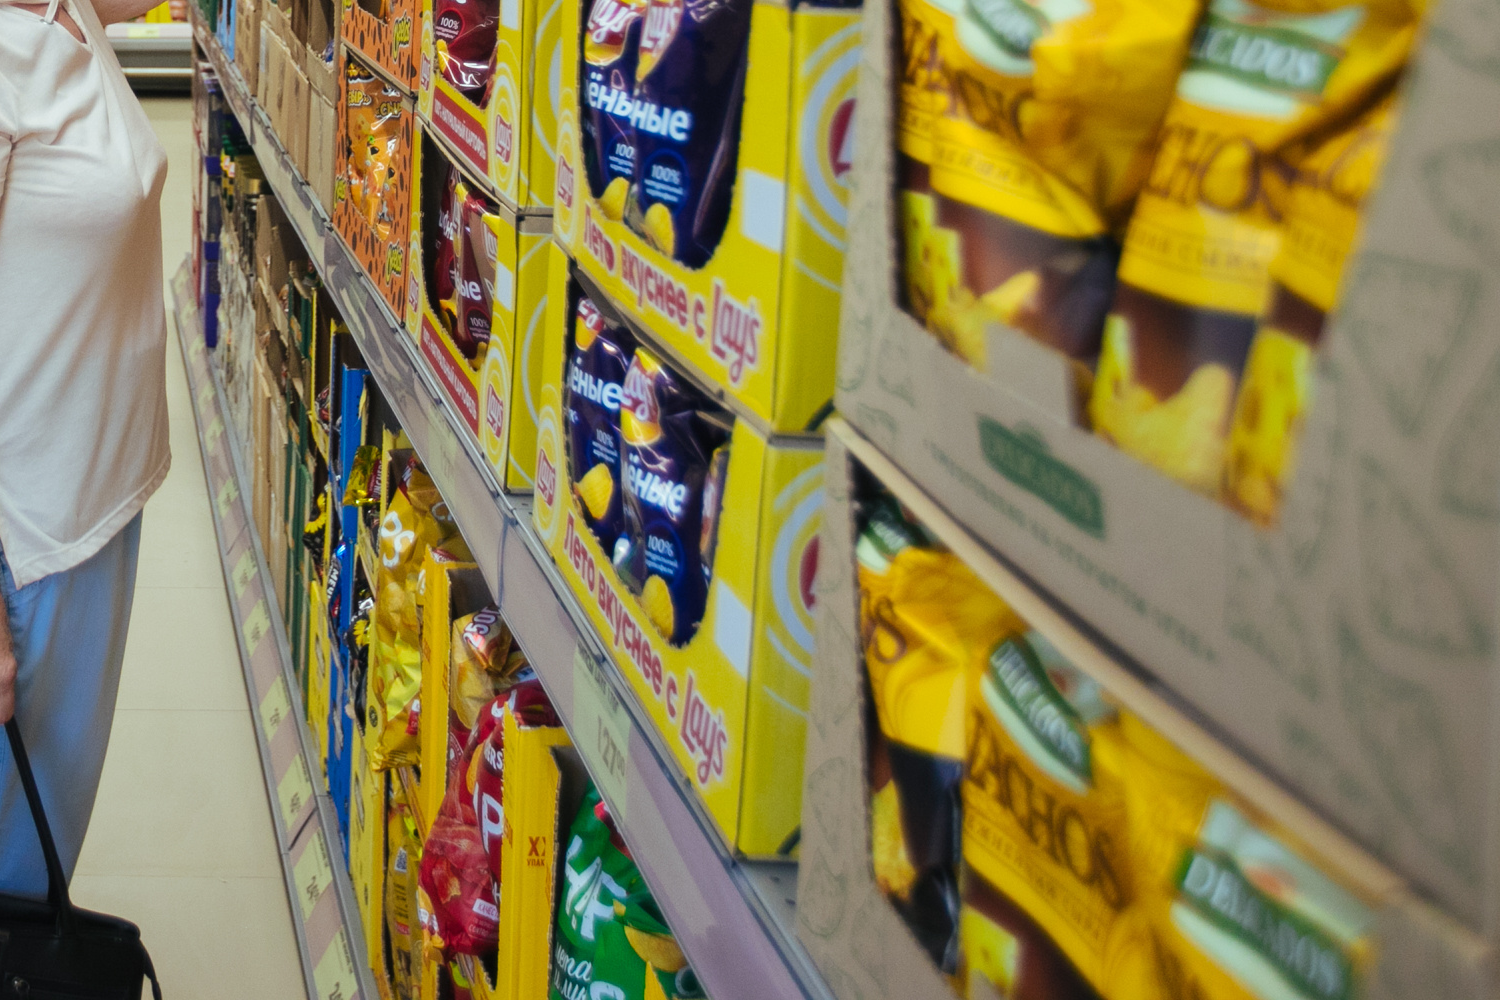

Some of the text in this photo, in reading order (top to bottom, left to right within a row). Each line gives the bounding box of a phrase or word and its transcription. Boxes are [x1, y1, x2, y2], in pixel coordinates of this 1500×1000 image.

[441, 16, 459, 31] 100%
[583, 199, 762, 386] Лето вкуснее с Lay's
[564, 508, 728, 786] Лето вкуснее с Lay's
